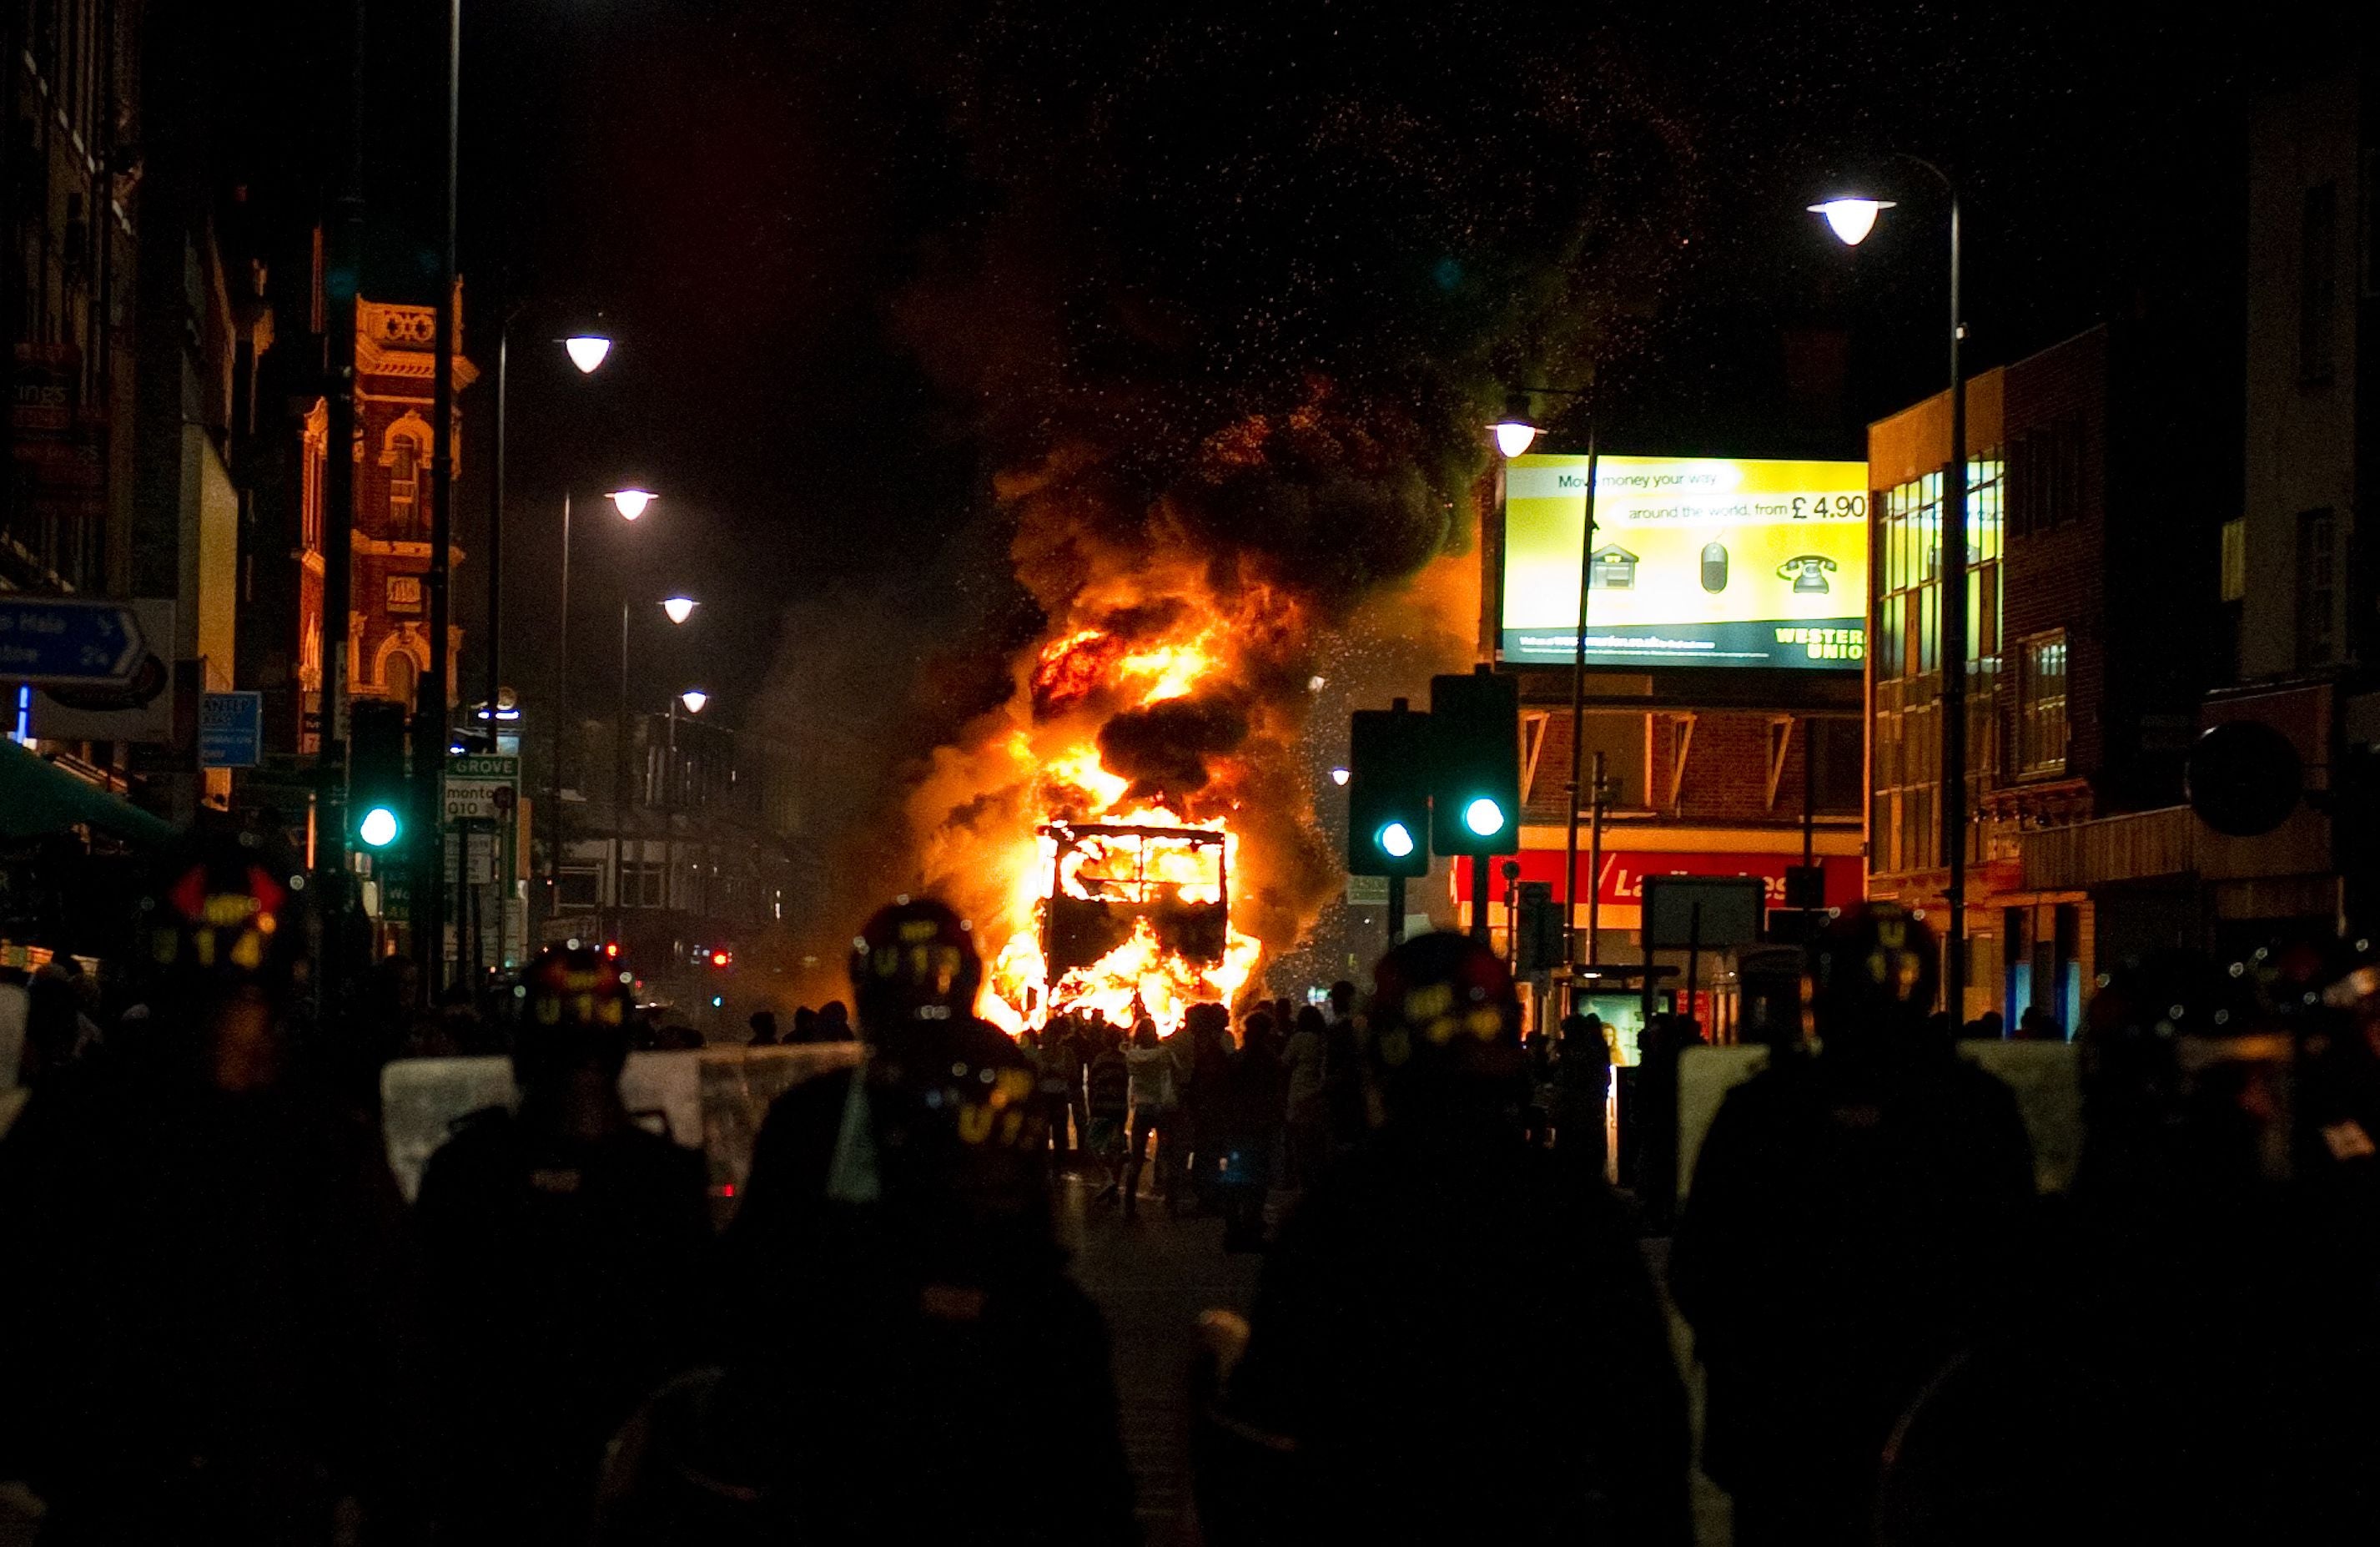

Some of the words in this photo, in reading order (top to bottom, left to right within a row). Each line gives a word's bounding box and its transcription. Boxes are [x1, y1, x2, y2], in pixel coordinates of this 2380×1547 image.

[1602, 475, 1649, 487] money
[1653, 474, 1684, 486] your
[1688, 473, 1717, 486] way
[1628, 506, 1678, 519] around
[1682, 504, 1703, 517] the
[1754, 502, 1787, 515] from
[1813, 495, 1866, 518] 4.90
[455, 758, 513, 774] GROVE
